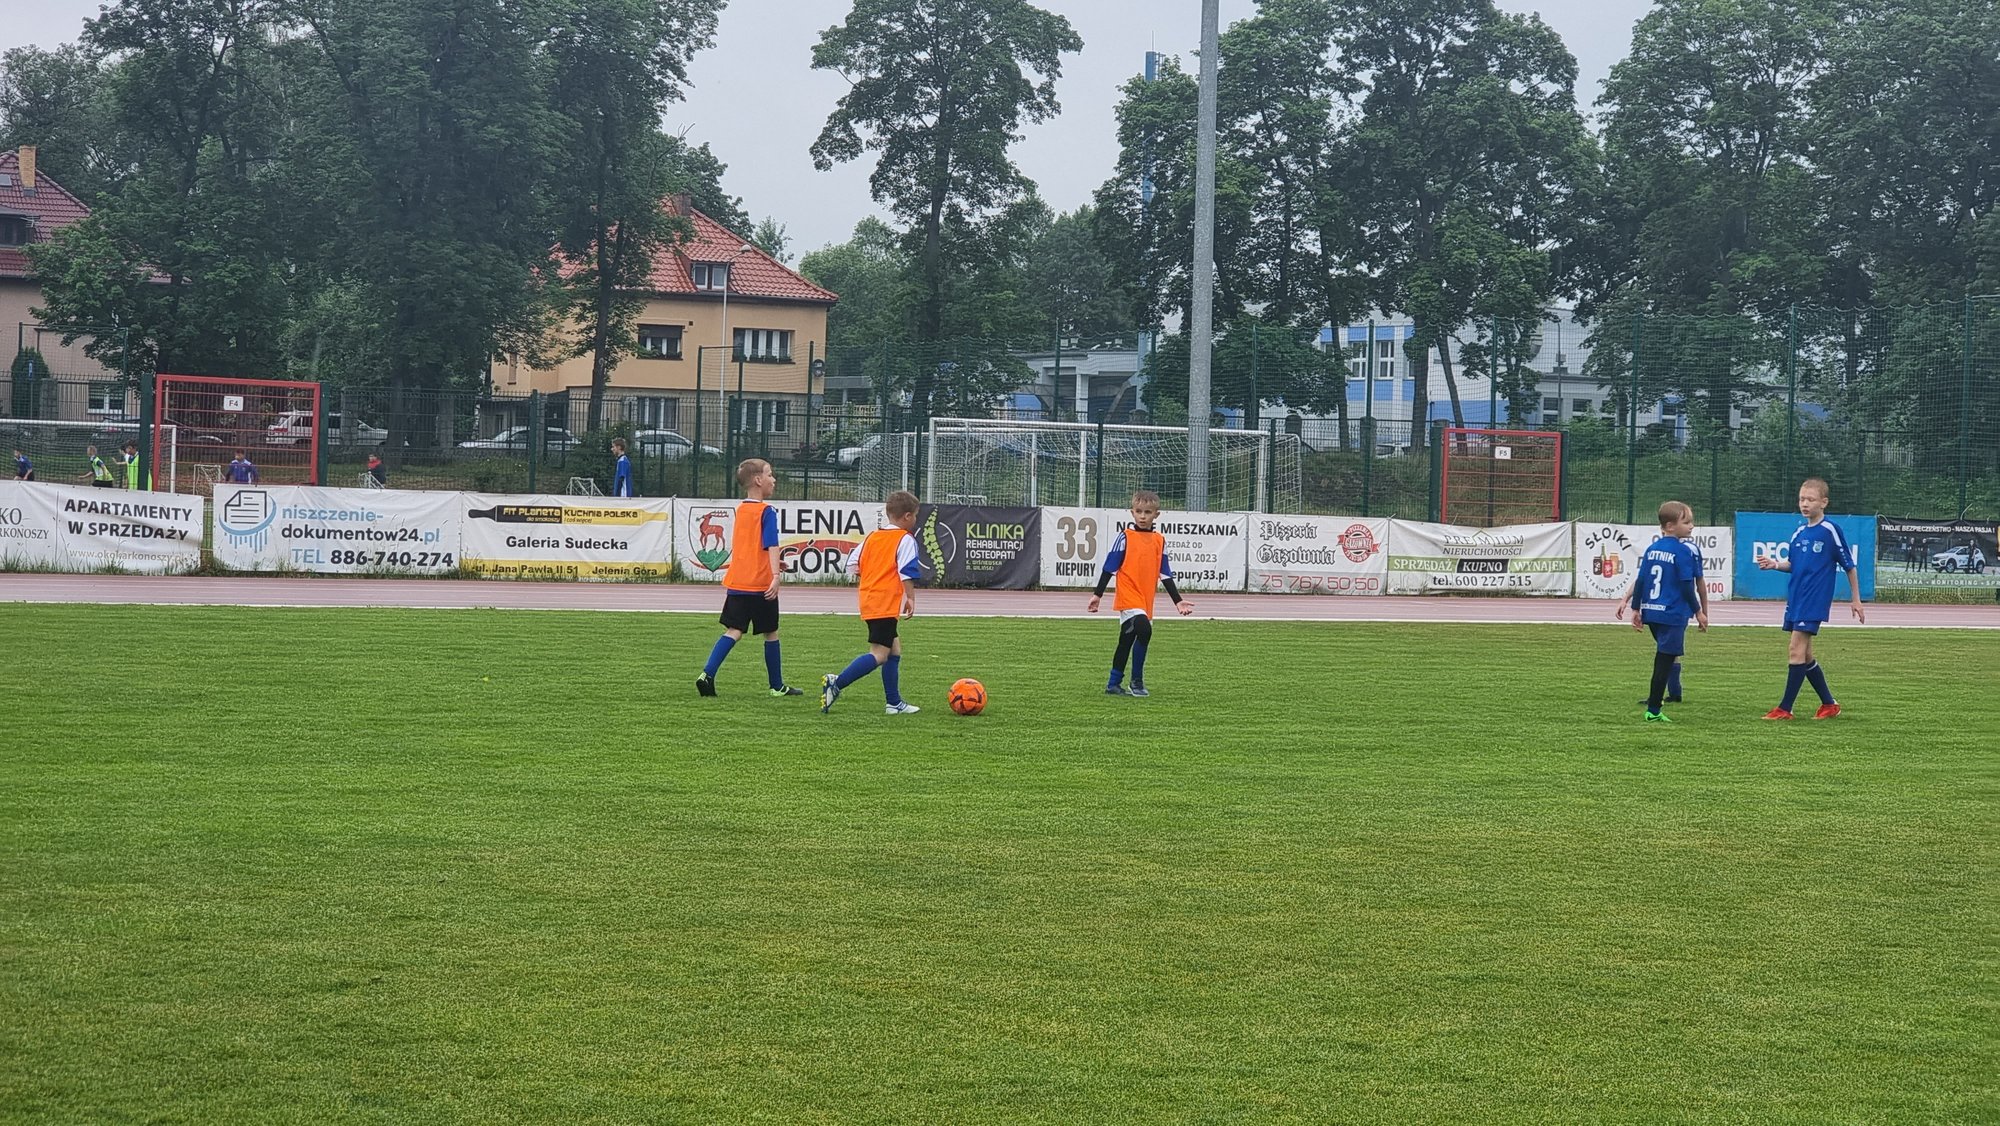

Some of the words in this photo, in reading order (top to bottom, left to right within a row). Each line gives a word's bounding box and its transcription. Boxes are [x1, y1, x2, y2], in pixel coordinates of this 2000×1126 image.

[64, 499, 192, 522] APARTAMENTY
[282, 506, 384, 522] niszczenie-
[778, 508, 865, 535] LENIA
[1116, 521, 1157, 533] NOE
[1160, 523, 1238, 536] MIESZKANIA
[68, 520, 84, 535] W
[88, 522, 188, 541] SPRZEDAŻY
[281, 523, 440, 546] dokumentow24.pl
[966, 523, 1025, 539] KLINIKA
[1056, 516, 1098, 561] 33
[1259, 520, 1318, 541] Pizzeria
[506, 535, 560, 549] Galeria
[565, 537, 628, 551] Sudecka
[965, 539, 1024, 552] REHABILITACJI
[1165, 540, 1190, 549] ZEDAŻ
[1192, 541, 1203, 549] OD
[1443, 534, 1524, 545] PREMIUM
[1585, 527, 1632, 551] SŁOIKI
[291, 549, 325, 564] TEL
[330, 550, 453, 567] 886-740-274
[780, 538, 858, 574] GÓR
[965, 549, 969, 559] I
[969, 550, 1016, 560] OSTEOPATII
[1167, 550, 1192, 562] ŚNIA
[1194, 553, 1218, 563] 2023
[1256, 543, 1336, 567] Gazownia
[1442, 545, 1522, 556] NIERUCHOMOŚCI
[491, 564, 518, 574] Jana
[520, 564, 553, 575] Pawła
[556, 565, 563, 574] II
[566, 565, 579, 576] 51
[592, 566, 630, 576] Jelenia
[633, 567, 658, 576] Góra
[1055, 562, 1096, 577] KIEPURY
[1393, 558, 1453, 571] SPRZEDAŻ
[1462, 561, 1503, 572] KUPNO
[1513, 561, 1567, 571] WYNAJEM
[1171, 569, 1229, 583] epury33.pl
[1259, 575, 1283, 588] 75
[1288, 576, 1323, 589] 767
[1327, 577, 1351, 590] 50
[1355, 578, 1379, 591] 50
[1433, 576, 1452, 586] tel.
[1455, 577, 1477, 586] 600
[1482, 577, 1505, 586] 227
[1509, 576, 1532, 586] 515
[1650, 565, 1663, 600] 3
[1706, 582, 1724, 594] 100
